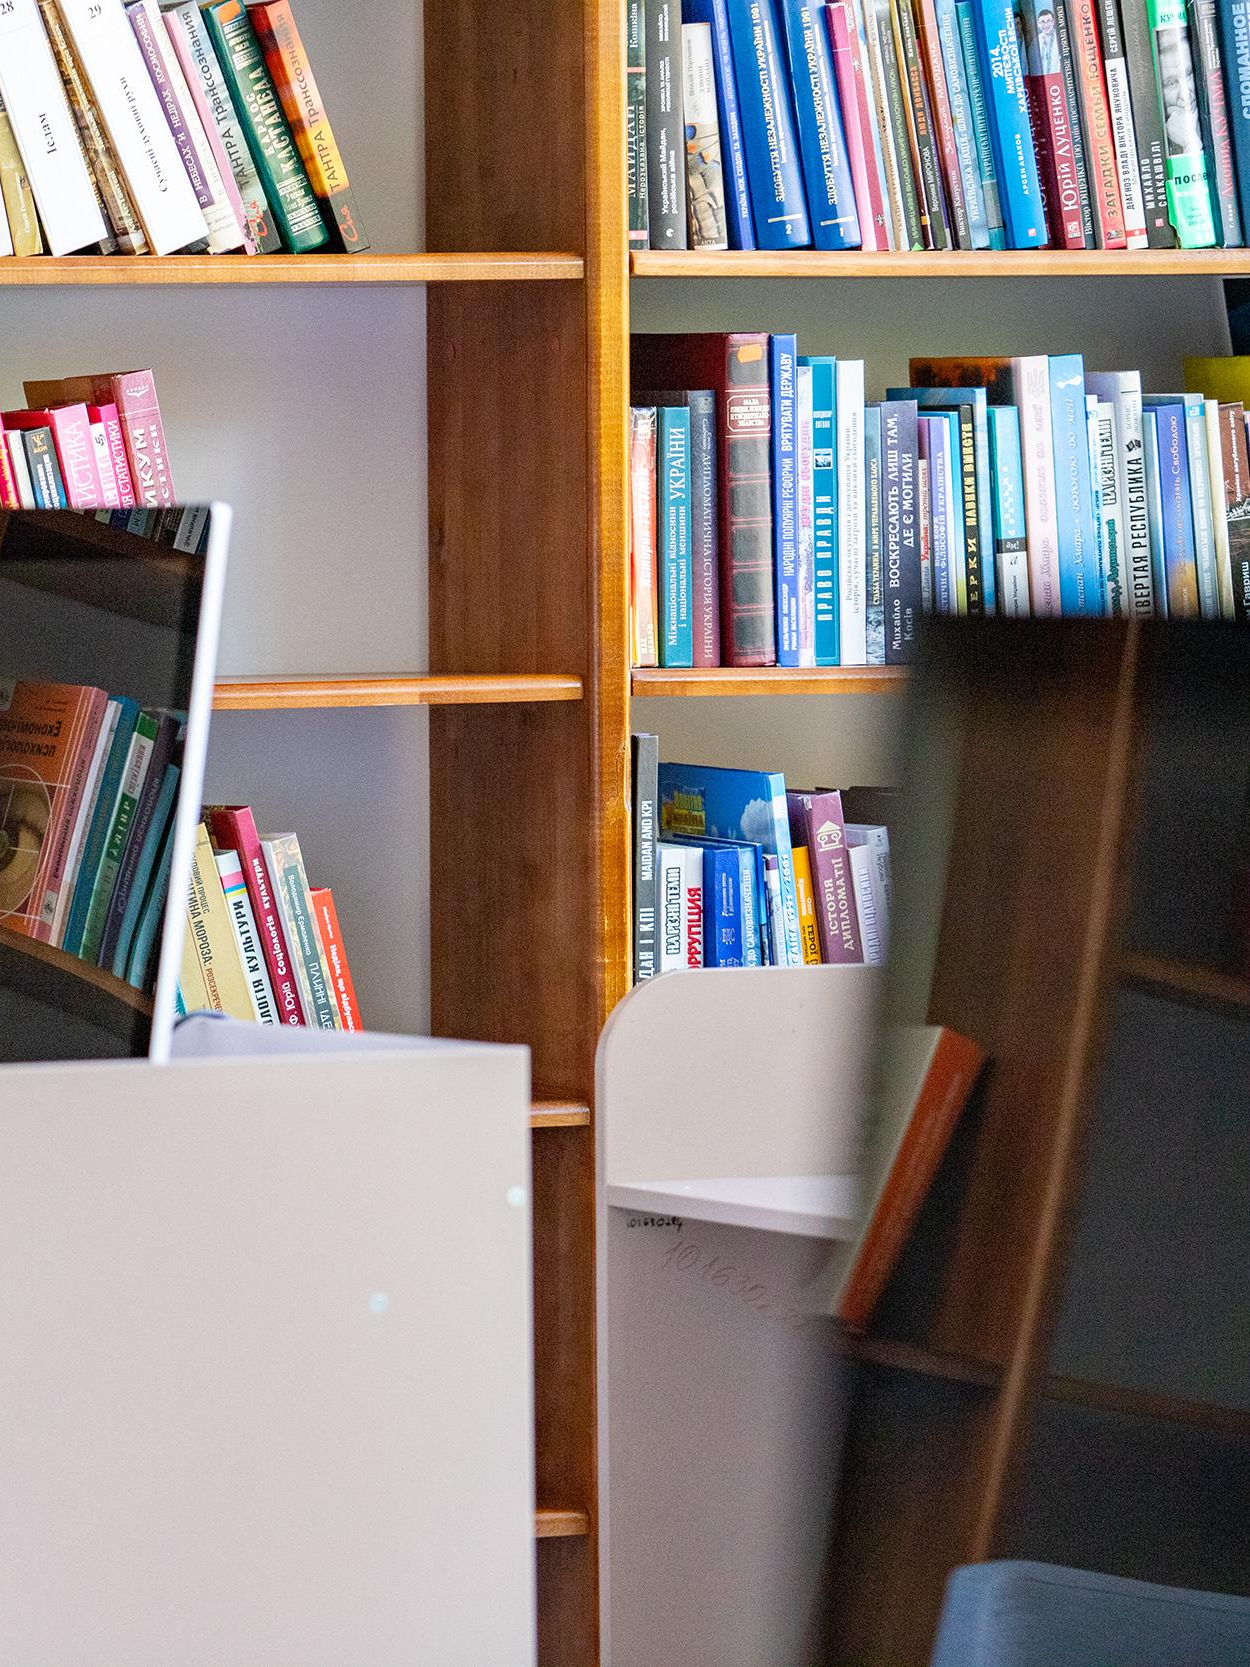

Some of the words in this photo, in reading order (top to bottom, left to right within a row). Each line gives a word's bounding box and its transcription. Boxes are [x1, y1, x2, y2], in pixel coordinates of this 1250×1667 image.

[87, 4, 103, 20] 29
[1003, 6, 1017, 42] ВЕСНИ
[1055, 5, 1065, 28] мова
[751, 25, 768, 69] УКРАЇНИ
[803, 28, 820, 72] УКРАЇНИ
[941, 13, 961, 93] САМОВИЗНАЧЕННЯ
[989, 44, 1004, 78] 2014.
[998, 29, 1016, 94] МИТТЄВОСТІ
[1107, 27, 1118, 53] СЕРГІЙ
[181, 10, 228, 126] Транссознания
[276, 12, 320, 128] Транссознания
[910, 64, 925, 109] ДОНБАССА
[1009, 42, 1029, 114] ХАРКІВСЬКОЇ
[1109, 67, 1123, 114] ЯНУКОВИЧА
[161, 88, 183, 128] НЕДРАХ
[246, 91, 275, 156] КАРЛОС
[247, 65, 296, 173] КАСТАНЕДА
[636, 104, 646, 138] історія
[758, 71, 779, 149] НЕЗАЛЕЖНОСТІ
[810, 74, 831, 153] НЕЗАЛЕЖНОСТІ
[917, 110, 928, 136] ЛЮДИ
[954, 93, 964, 106] ДО
[955, 107, 969, 132] ШЛЯХ
[1091, 83, 1108, 139] СЕМЬИ
[37, 112, 57, 154] Іслам
[127, 105, 152, 145] духовні
[658, 126, 669, 162] Майдан,
[1115, 115, 1128, 148] ВІКТОРА
[181, 145, 204, 191] НЕБЕСАХ
[221, 127, 250, 190] ТАНТРА
[314, 129, 342, 193] ТАНТРА
[638, 142, 647, 199] Нерозказана
[668, 149, 677, 172] війна
[1014, 133, 1025, 167] АВАКОВ
[1073, 144, 1084, 158] 100
[1119, 149, 1132, 176] ВЛАДІ
[659, 163, 670, 215] Український
[668, 173, 679, 214] російська
[770, 150, 786, 203] ЗДОБУТТЯ
[821, 154, 838, 206] ЗДОБУТТЯ
[950, 169, 963, 207] Капустин
[966, 165, 981, 222] УКРАЇНСЬКА
[1020, 166, 1030, 196] АРСЕН
[1098, 143, 1118, 218] ЗАГАДКИ
[1122, 176, 1135, 210] ДІАГНОЗ
[1140, 157, 1156, 210] МИХАЙЛО
[1151, 140, 1167, 207] СААКАШВІЛІ
[955, 207, 967, 236] Виктор
[1083, 205, 1096, 235] Віктор
[779, 352, 794, 397] ДЕРЖАВУ
[779, 398, 794, 452] ВРЯТУВАТИ
[886, 414, 899, 446] ТАМ,
[961, 423, 974, 472] ВМЕСТЕ
[1168, 415, 1181, 475] Свободою
[107, 419, 131, 493] СТАТИСТИКИ
[666, 426, 686, 501] УКРАЇНИ
[780, 457, 794, 498] РЕФОРМИ
[887, 449, 899, 481] ЛИШ
[700, 453, 714, 556] ДИПЛОМАТИЧНА
[901, 452, 914, 511] МОГИЛИ
[964, 476, 977, 526] НАВЕКИ
[1126, 457, 1149, 543] РЕСПУБЛИКА
[1234, 473, 1242, 502] Хроніки
[667, 505, 677, 559] відносини
[678, 505, 686, 555] меншини
[815, 494, 834, 558] ПРАВДИ
[888, 485, 901, 588] ВОСКРЕСАЮТЬ
[901, 527, 915, 548] ДЕ
[920, 523, 930, 561] Україна:
[937, 514, 948, 569] ФІЛОСОФІЯ
[702, 557, 714, 604] ІСТОРІЯ
[782, 540, 795, 577] НАРОДНІ
[667, 562, 678, 646] Міжнаціональні
[676, 558, 688, 621] національні
[816, 568, 833, 621] ПРАВО
[702, 606, 714, 658] УКРАЇНИ
[891, 598, 902, 650] Михайло
[903, 607, 913, 641] Косів
[641, 800, 653, 818] KPI
[641, 819, 653, 840] AND
[252, 857, 271, 910] культури
[641, 841, 653, 881] MAIDAN
[196, 886, 210, 915] ПРОЦЕС
[638, 907, 655, 932] КПІ
[742, 868, 755, 948] САМОВИЗНАЧЕННЯ
[824, 878, 839, 936] ІСТОРІЯ
[831, 857, 855, 951] ДИПЛОМАТІЇ
[193, 919, 214, 967] МОРОЗА:
[232, 899, 260, 974] КУЛЬТУРИ
[265, 914, 287, 976] Соціологія
[287, 874, 302, 915] Володимир
[297, 915, 312, 956] Єрмоленко
[308, 961, 327, 1005] ПЛИННІ
[746, 949, 756, 961] ДО
[329, 943, 341, 977] Неділя,
[336, 977, 346, 992] що
[280, 981, 296, 1011] Юрій
